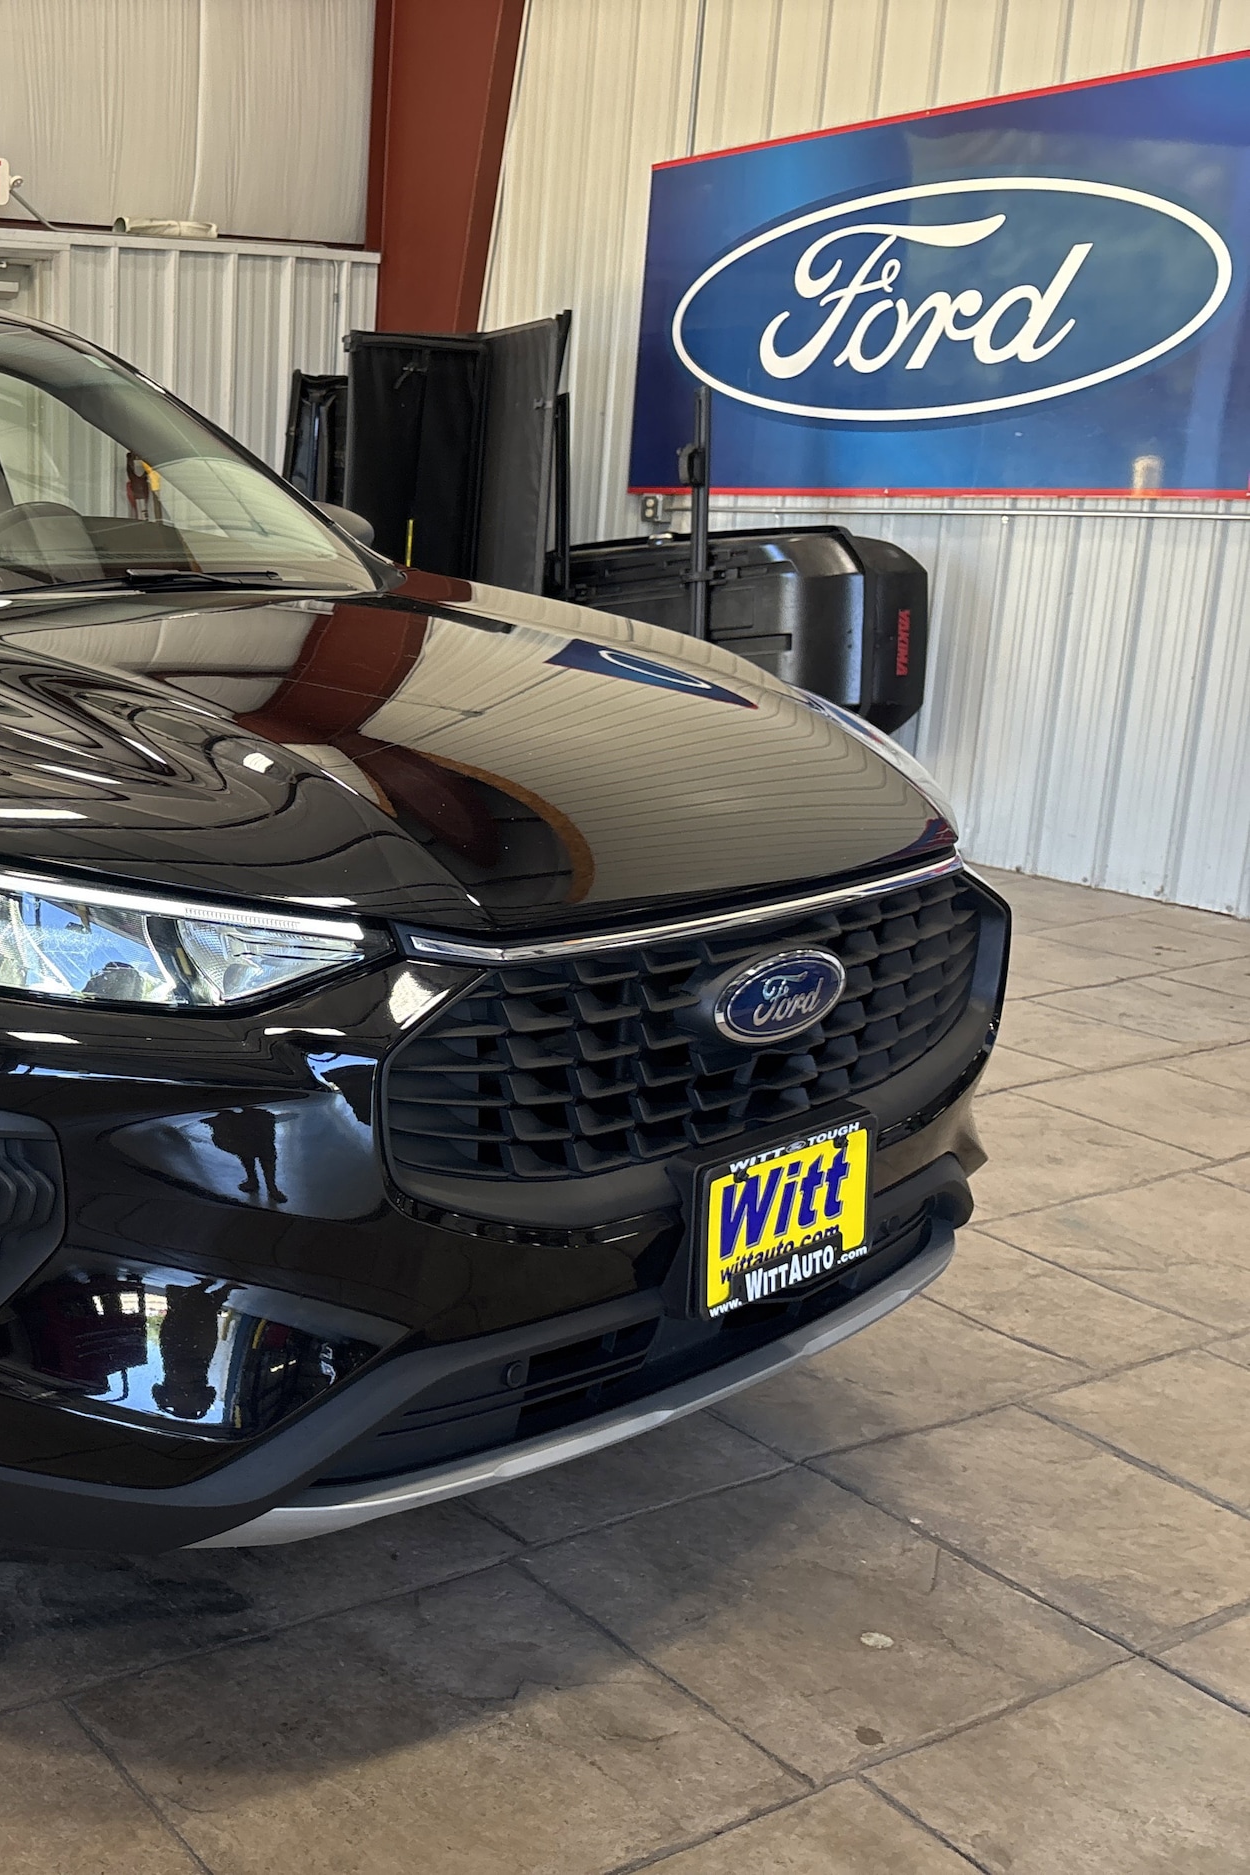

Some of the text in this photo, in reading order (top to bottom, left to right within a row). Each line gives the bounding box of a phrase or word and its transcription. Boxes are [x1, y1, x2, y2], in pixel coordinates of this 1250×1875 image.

[759, 213, 1093, 379] Ford
[896, 609, 911, 676] YAKIMA
[753, 971, 824, 1027] Ford
[729, 1147, 786, 1173] WITT
[807, 1121, 860, 1146] TOUGH
[720, 1147, 851, 1261] Witt
[721, 1224, 839, 1284] wittautocom
